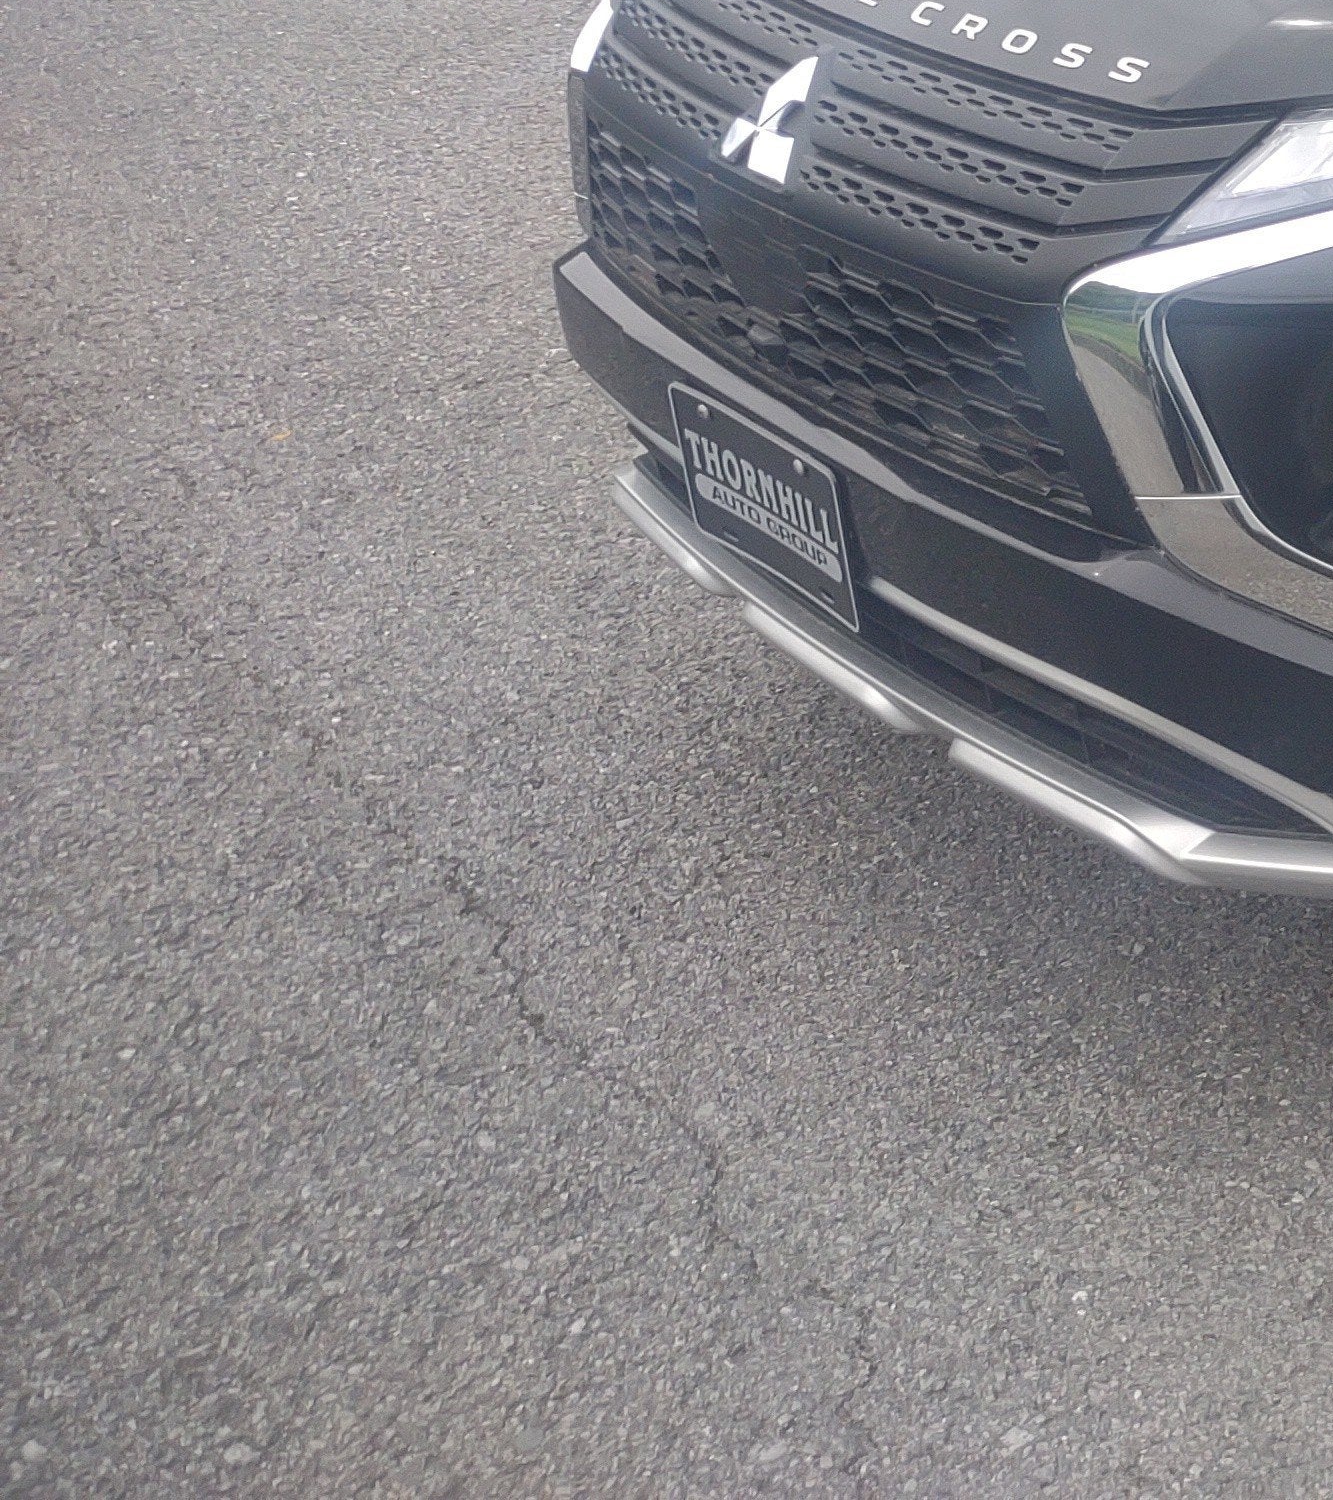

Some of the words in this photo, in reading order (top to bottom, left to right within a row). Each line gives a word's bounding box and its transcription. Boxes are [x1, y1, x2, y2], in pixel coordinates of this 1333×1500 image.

[910, 0, 1151, 83] CROSS
[684, 428, 839, 555] THORNHILL
[712, 485, 761, 525] AUTO
[766, 518, 828, 566] GROUP
